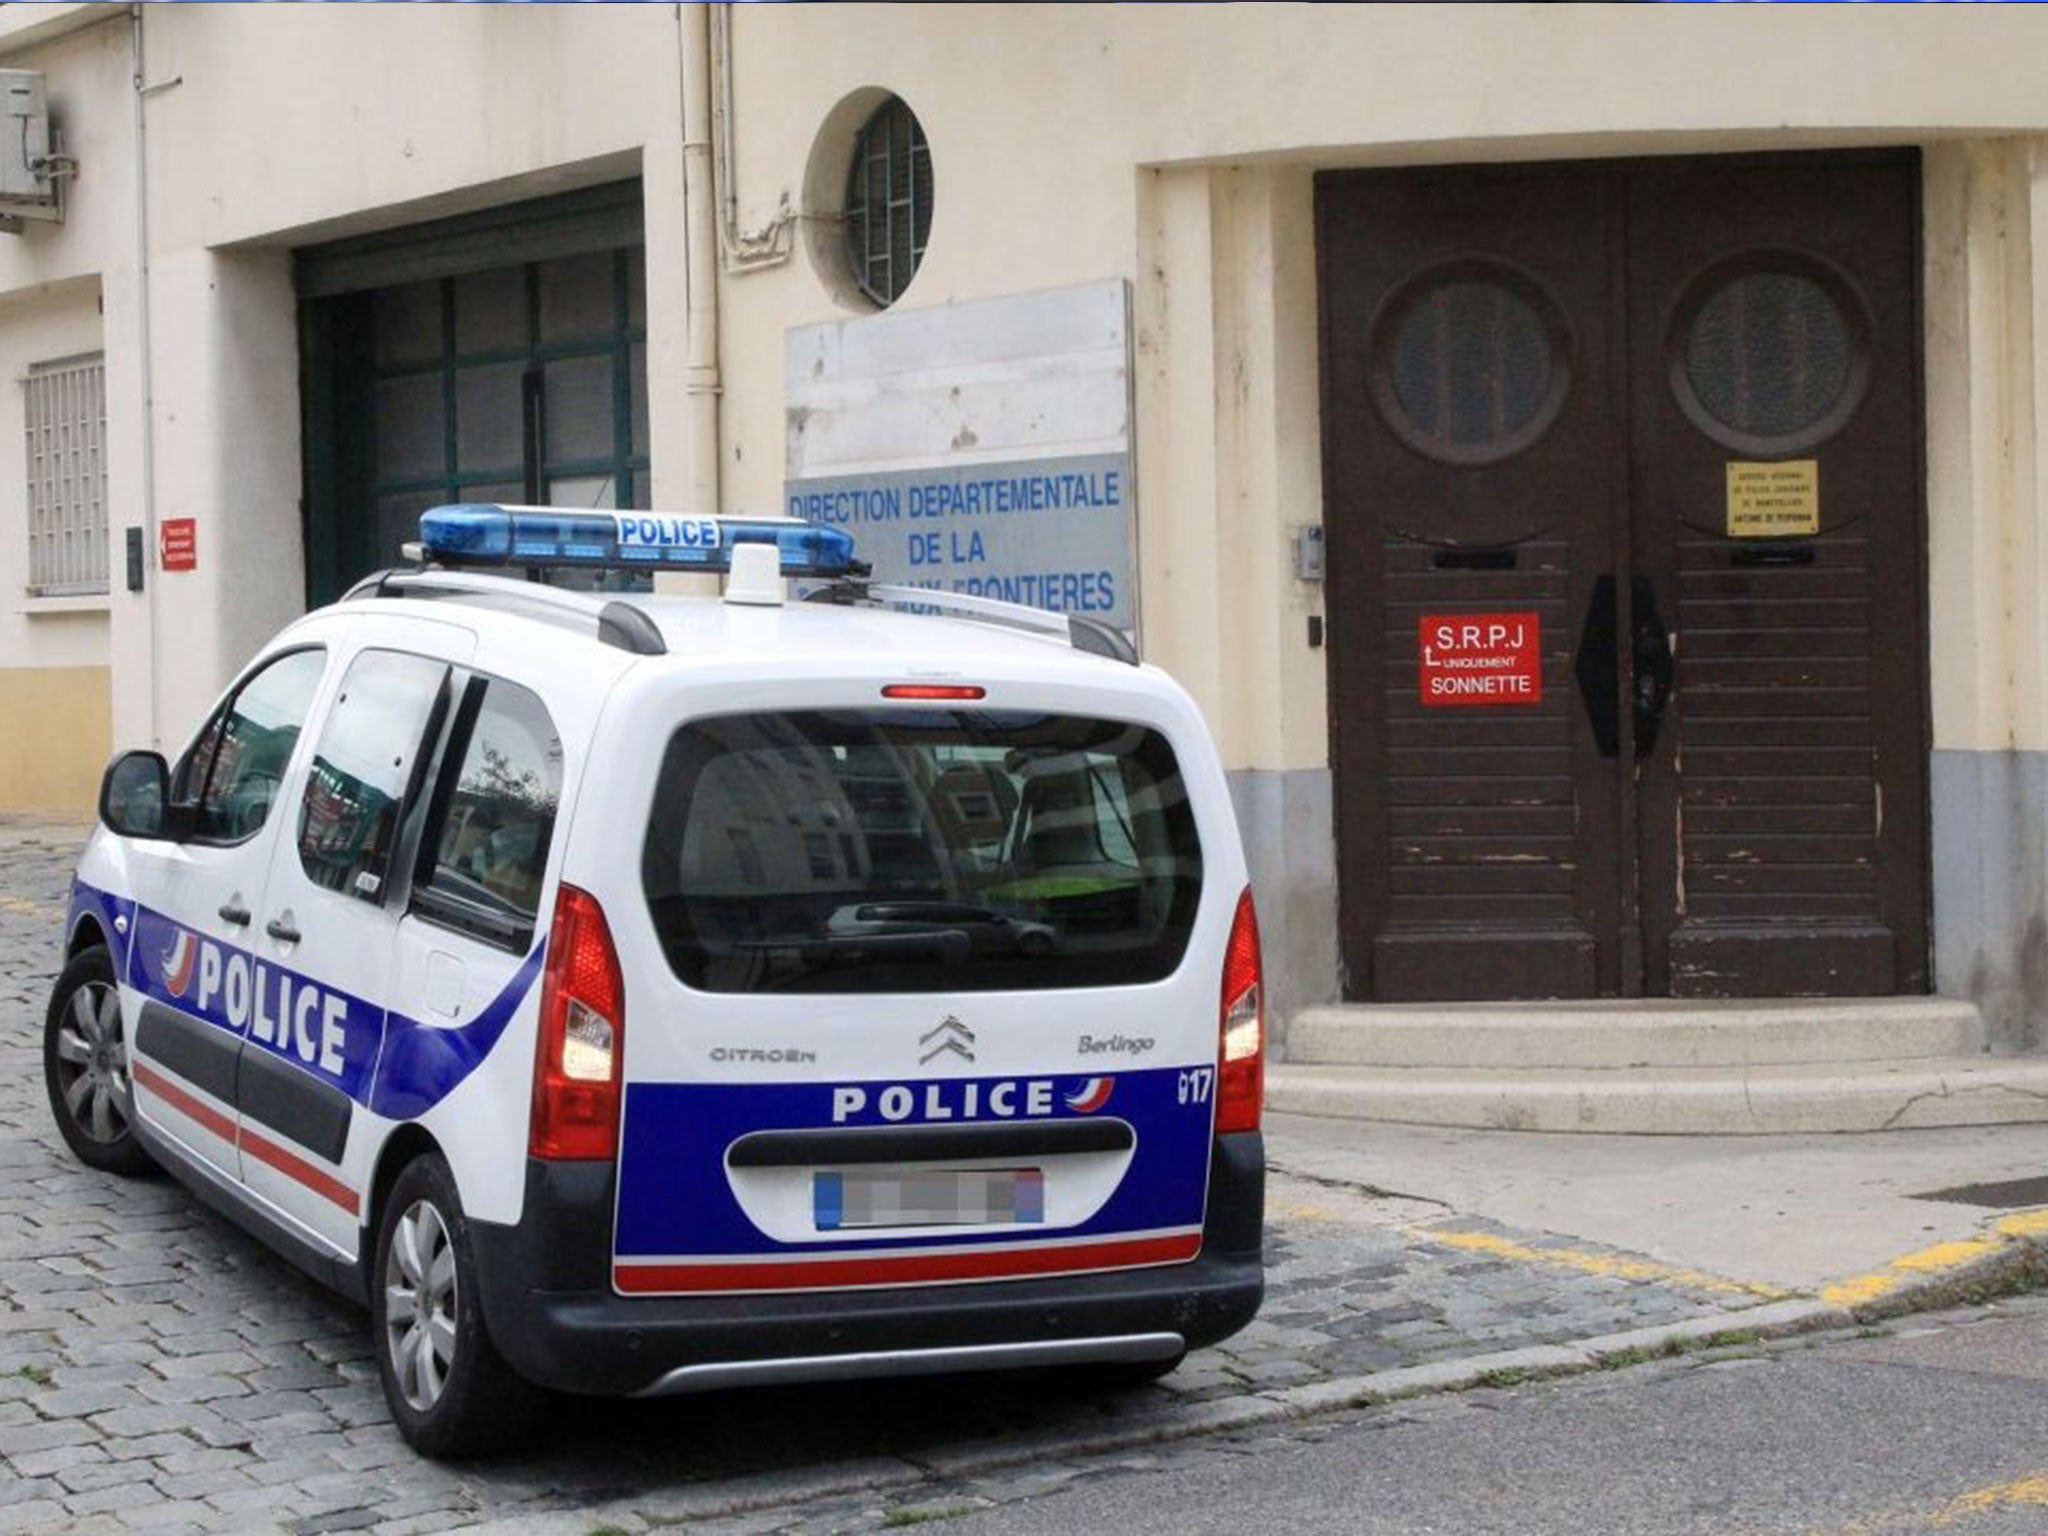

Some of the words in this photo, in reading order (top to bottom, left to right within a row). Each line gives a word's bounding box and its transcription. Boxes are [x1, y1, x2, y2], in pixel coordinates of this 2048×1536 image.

[789, 487, 900, 522] DIRECTION
[908, 472, 1120, 519] DEPARTEMENTALE
[620, 517, 716, 546] POLICE
[908, 533, 943, 566] DE
[951, 530, 986, 563] LA
[1436, 624, 1524, 650] S.R.P.J
[1442, 656, 1516, 669] UNIQUEMENT
[1430, 675, 1532, 695] SONNETTE
[197, 941, 348, 1077] POLICE
[1077, 1034, 1155, 1055] Berlingo
[832, 1081, 1054, 1123] POLICE
